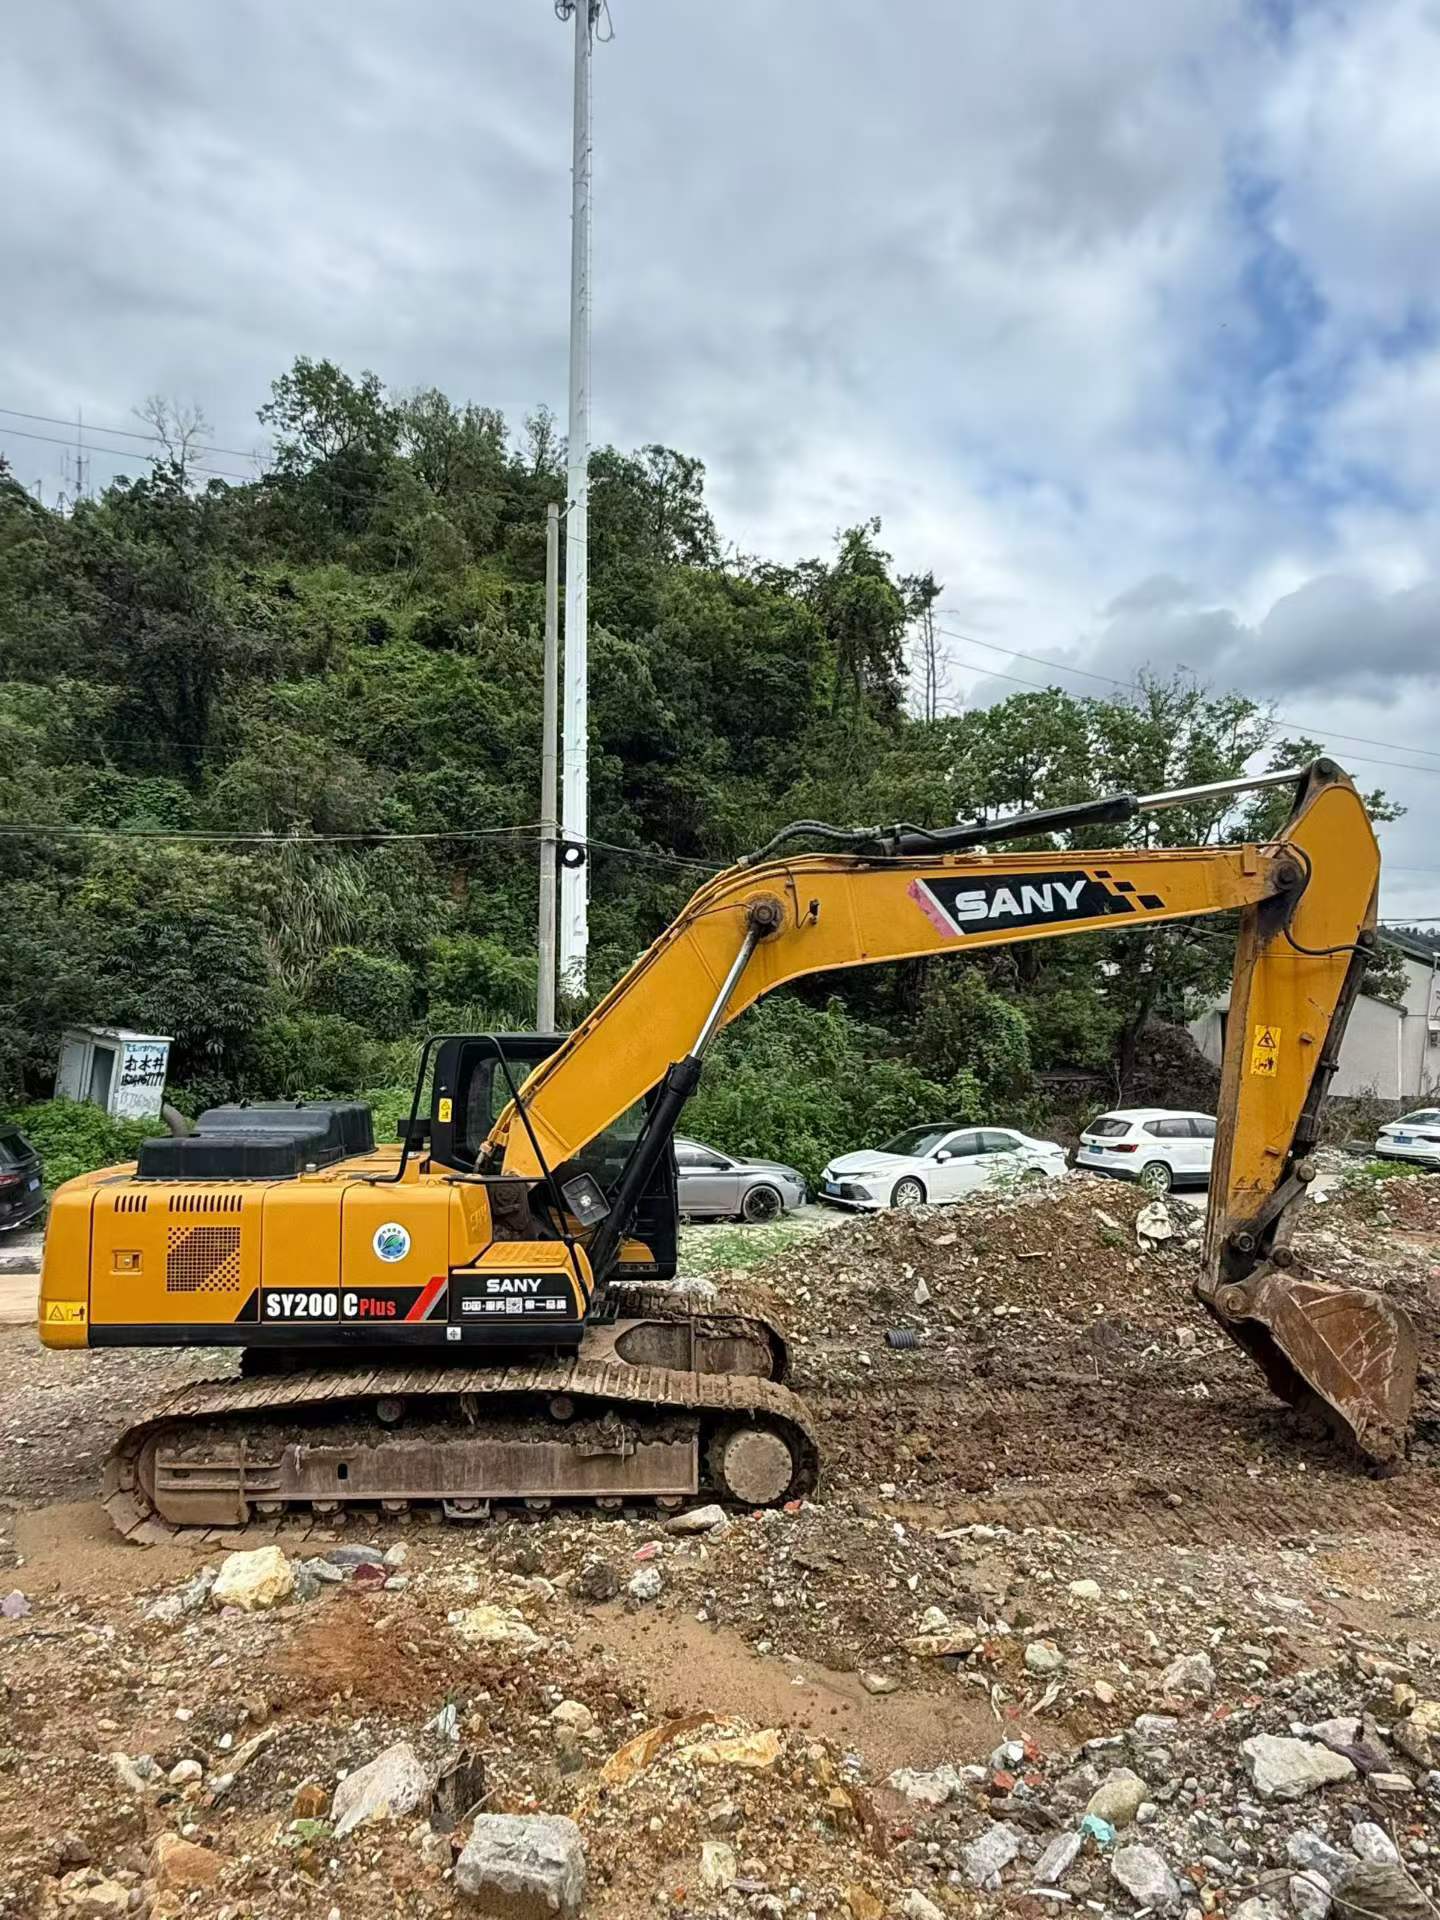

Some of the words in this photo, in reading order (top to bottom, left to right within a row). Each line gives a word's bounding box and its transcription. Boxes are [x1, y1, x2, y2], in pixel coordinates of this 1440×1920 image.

[955, 880, 1087, 921] SANY
[124, 1053, 164, 1071] 打水井
[486, 1278, 541, 1293] SANY
[266, 1293, 337, 1317] SY200
[343, 1293, 358, 1317] C
[359, 1298, 396, 1316] Plus
